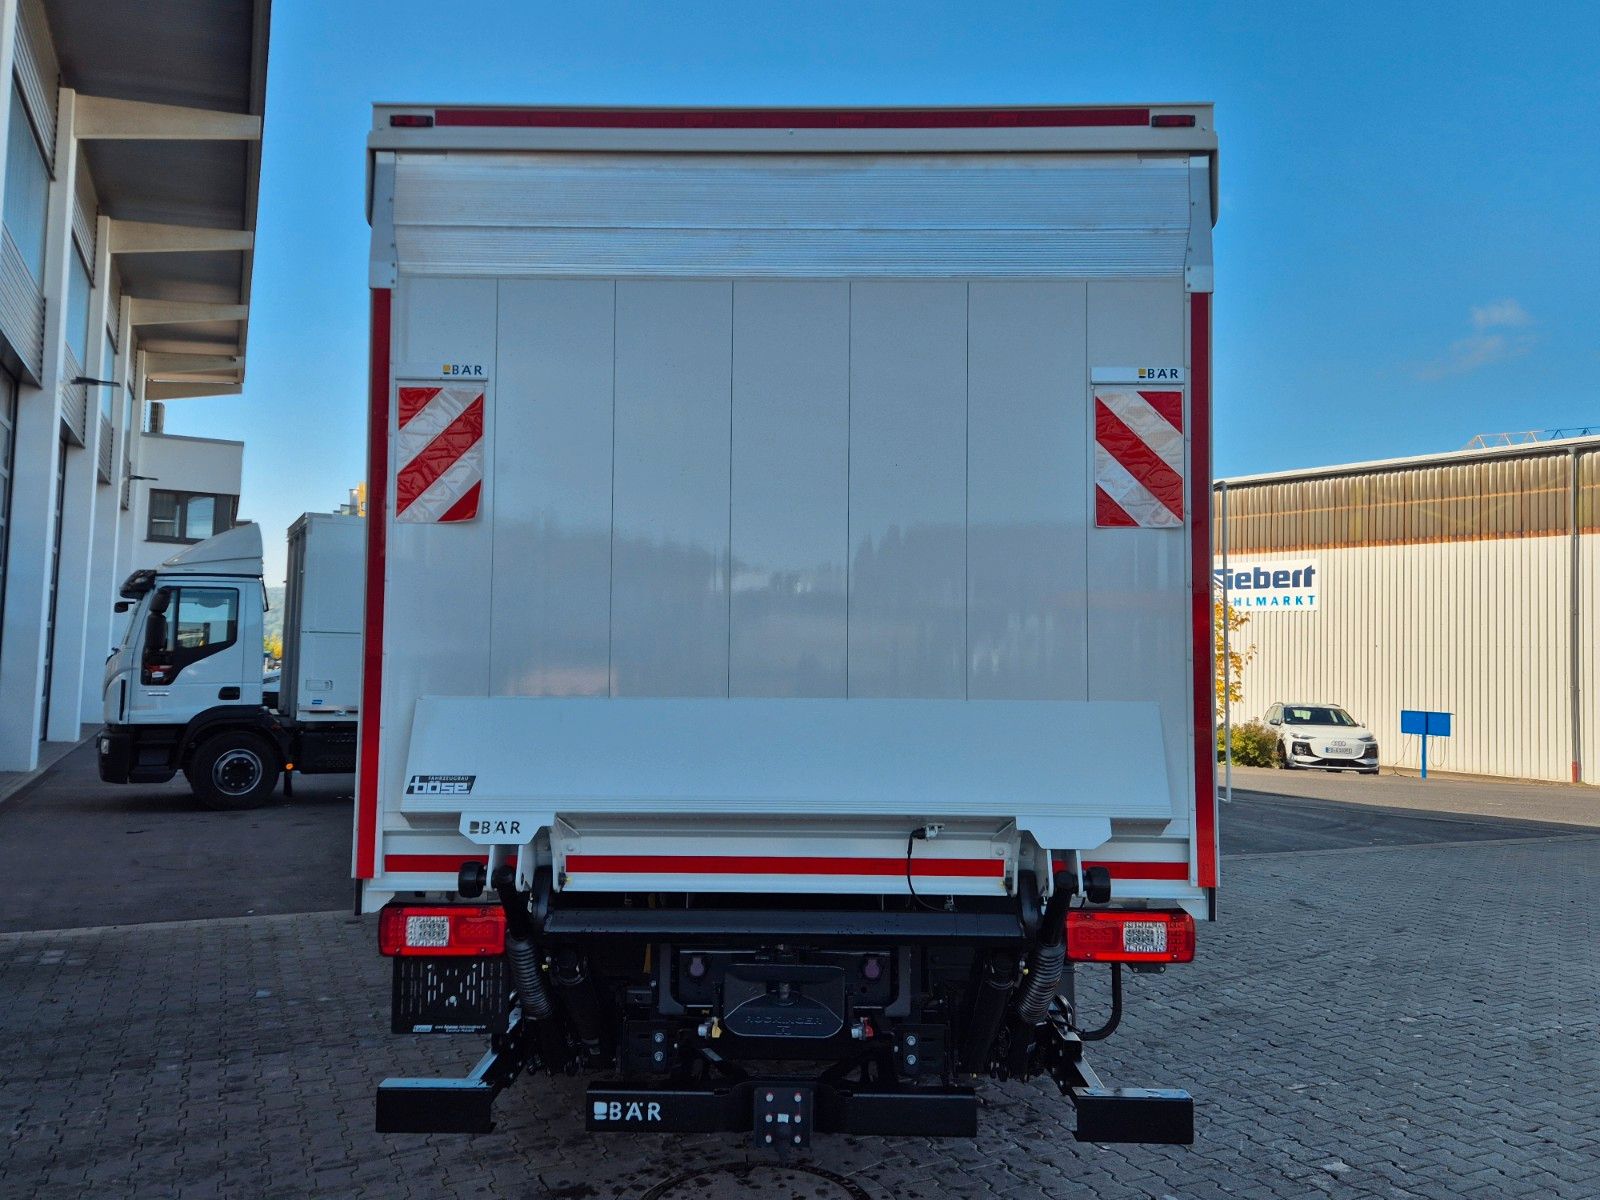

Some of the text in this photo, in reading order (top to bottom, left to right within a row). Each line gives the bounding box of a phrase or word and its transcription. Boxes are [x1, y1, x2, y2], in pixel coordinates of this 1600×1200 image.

[452, 364, 482, 375] BÄR
[1147, 368, 1178, 379] BÄR
[1225, 595, 1316, 606] HLMARKT
[411, 776, 470, 794] böse
[481, 821, 521, 834] BÄR
[609, 1101, 662, 1121] BÄR
